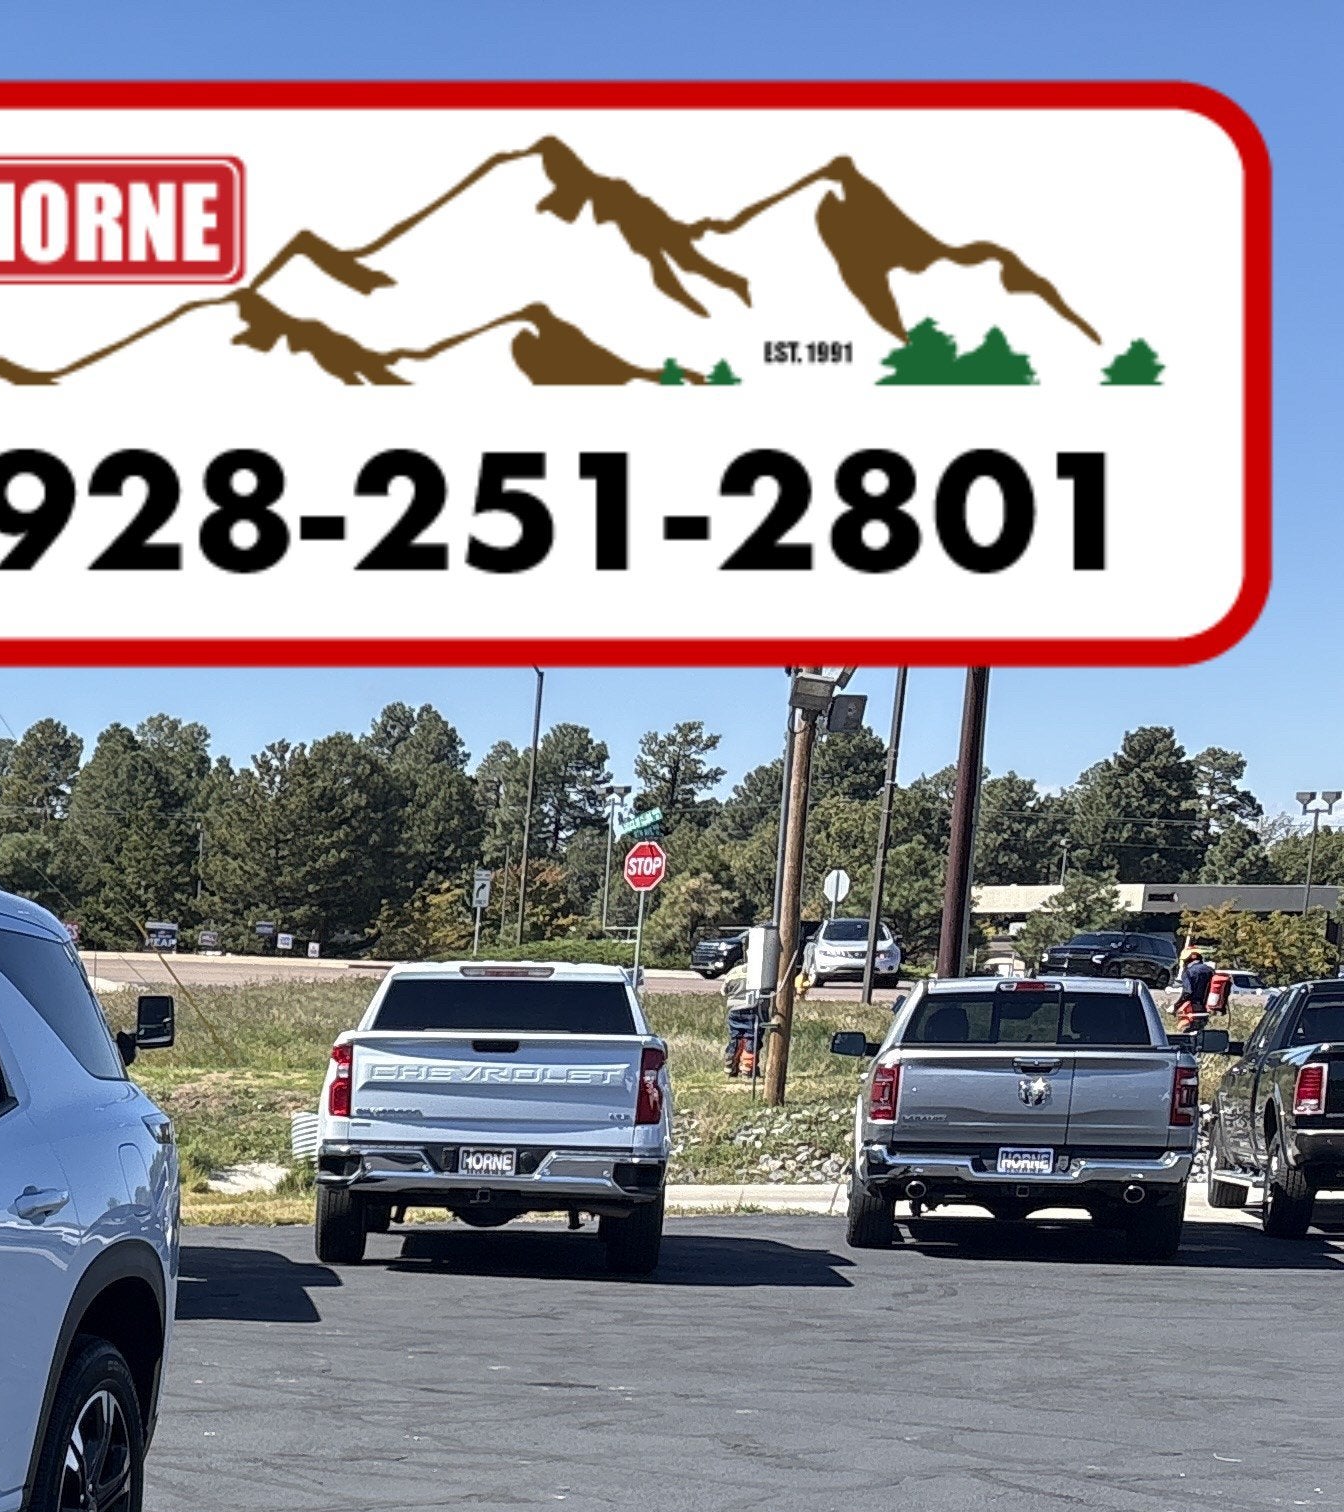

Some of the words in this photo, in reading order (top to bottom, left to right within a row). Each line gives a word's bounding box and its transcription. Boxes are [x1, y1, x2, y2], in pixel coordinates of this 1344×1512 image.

[627, 856, 662, 876] STOP
[372, 1064, 623, 1085] CHEVROLET
[463, 1153, 513, 1171] HORNE
[1001, 1153, 1050, 1169] HORNE
